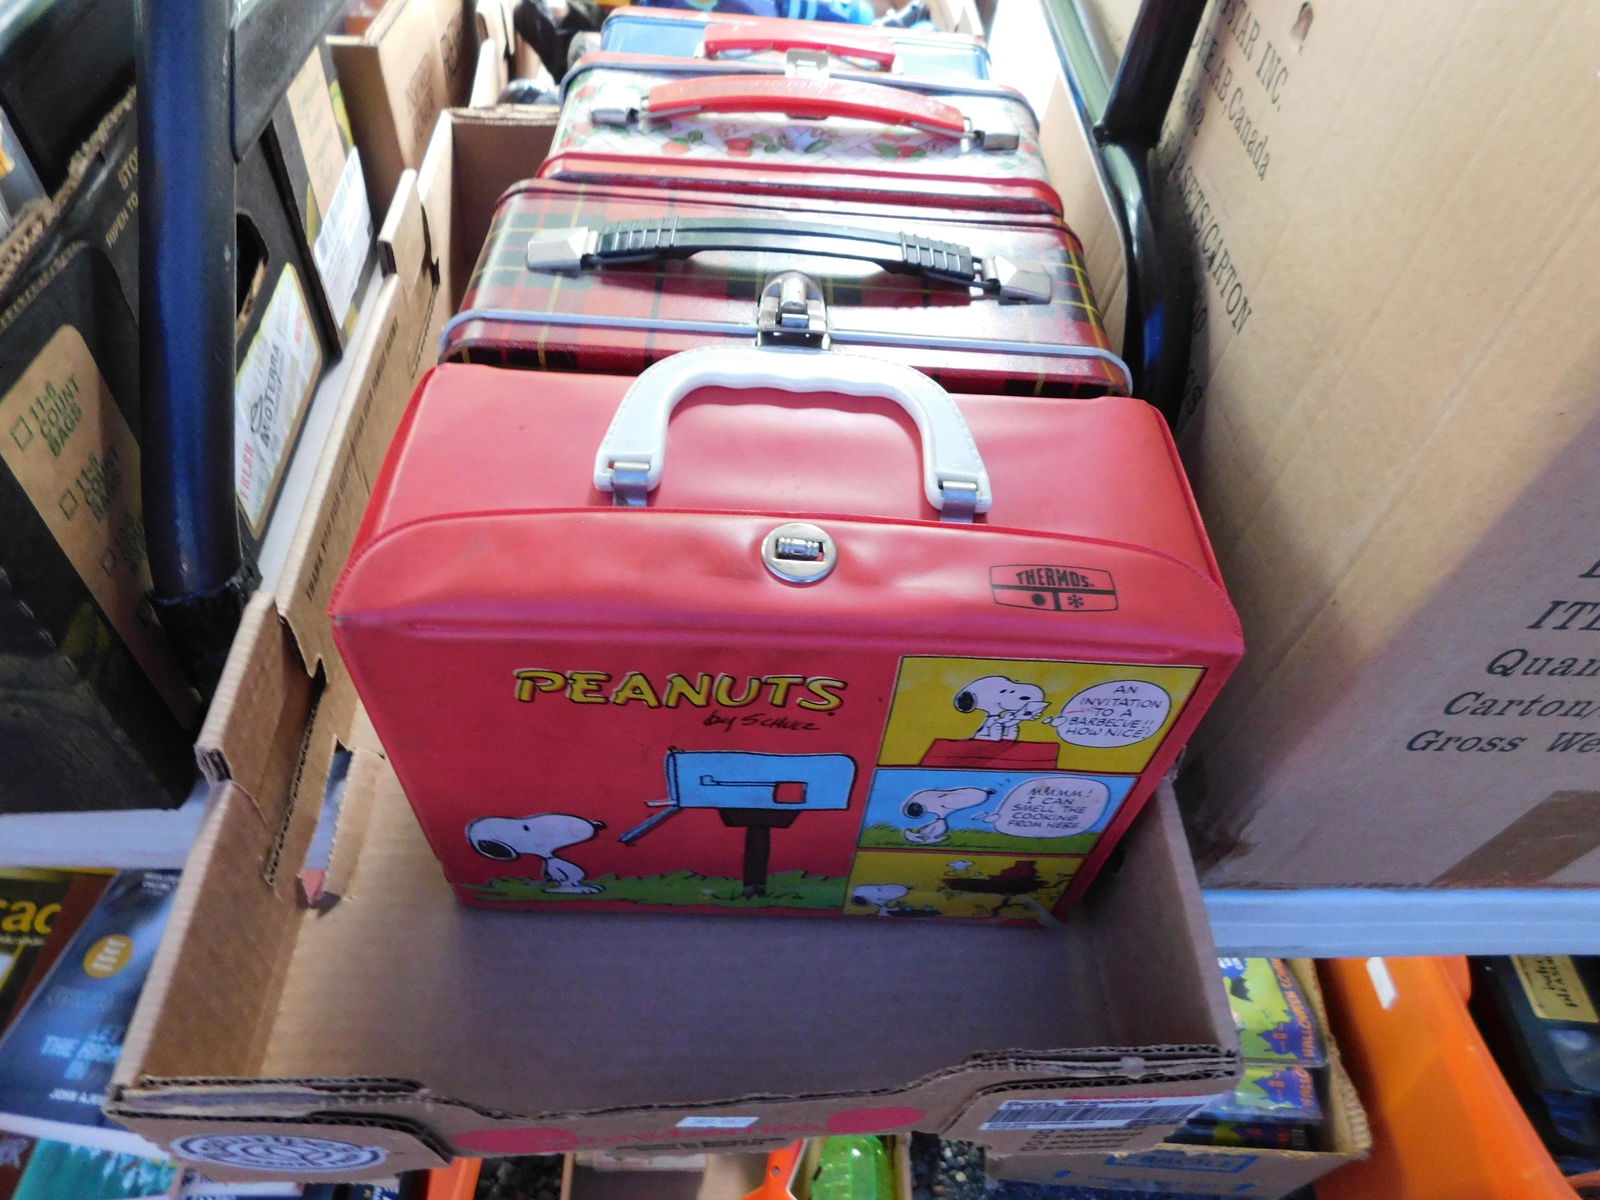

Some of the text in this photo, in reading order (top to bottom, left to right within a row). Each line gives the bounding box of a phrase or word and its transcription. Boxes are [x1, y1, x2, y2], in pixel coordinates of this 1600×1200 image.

[1256, 40, 1289, 112] INC.
[1113, 685, 1138, 694] AN
[1079, 697, 1162, 709] INVITATION
[1095, 707, 1132, 717] TO A
[703, 711, 735, 732] by
[1065, 727, 1101, 736] HOW
[1406, 729, 1528, 753] Gross
[1011, 804, 1087, 814] SMELL THE
[1012, 812, 1079, 821] COOKING
